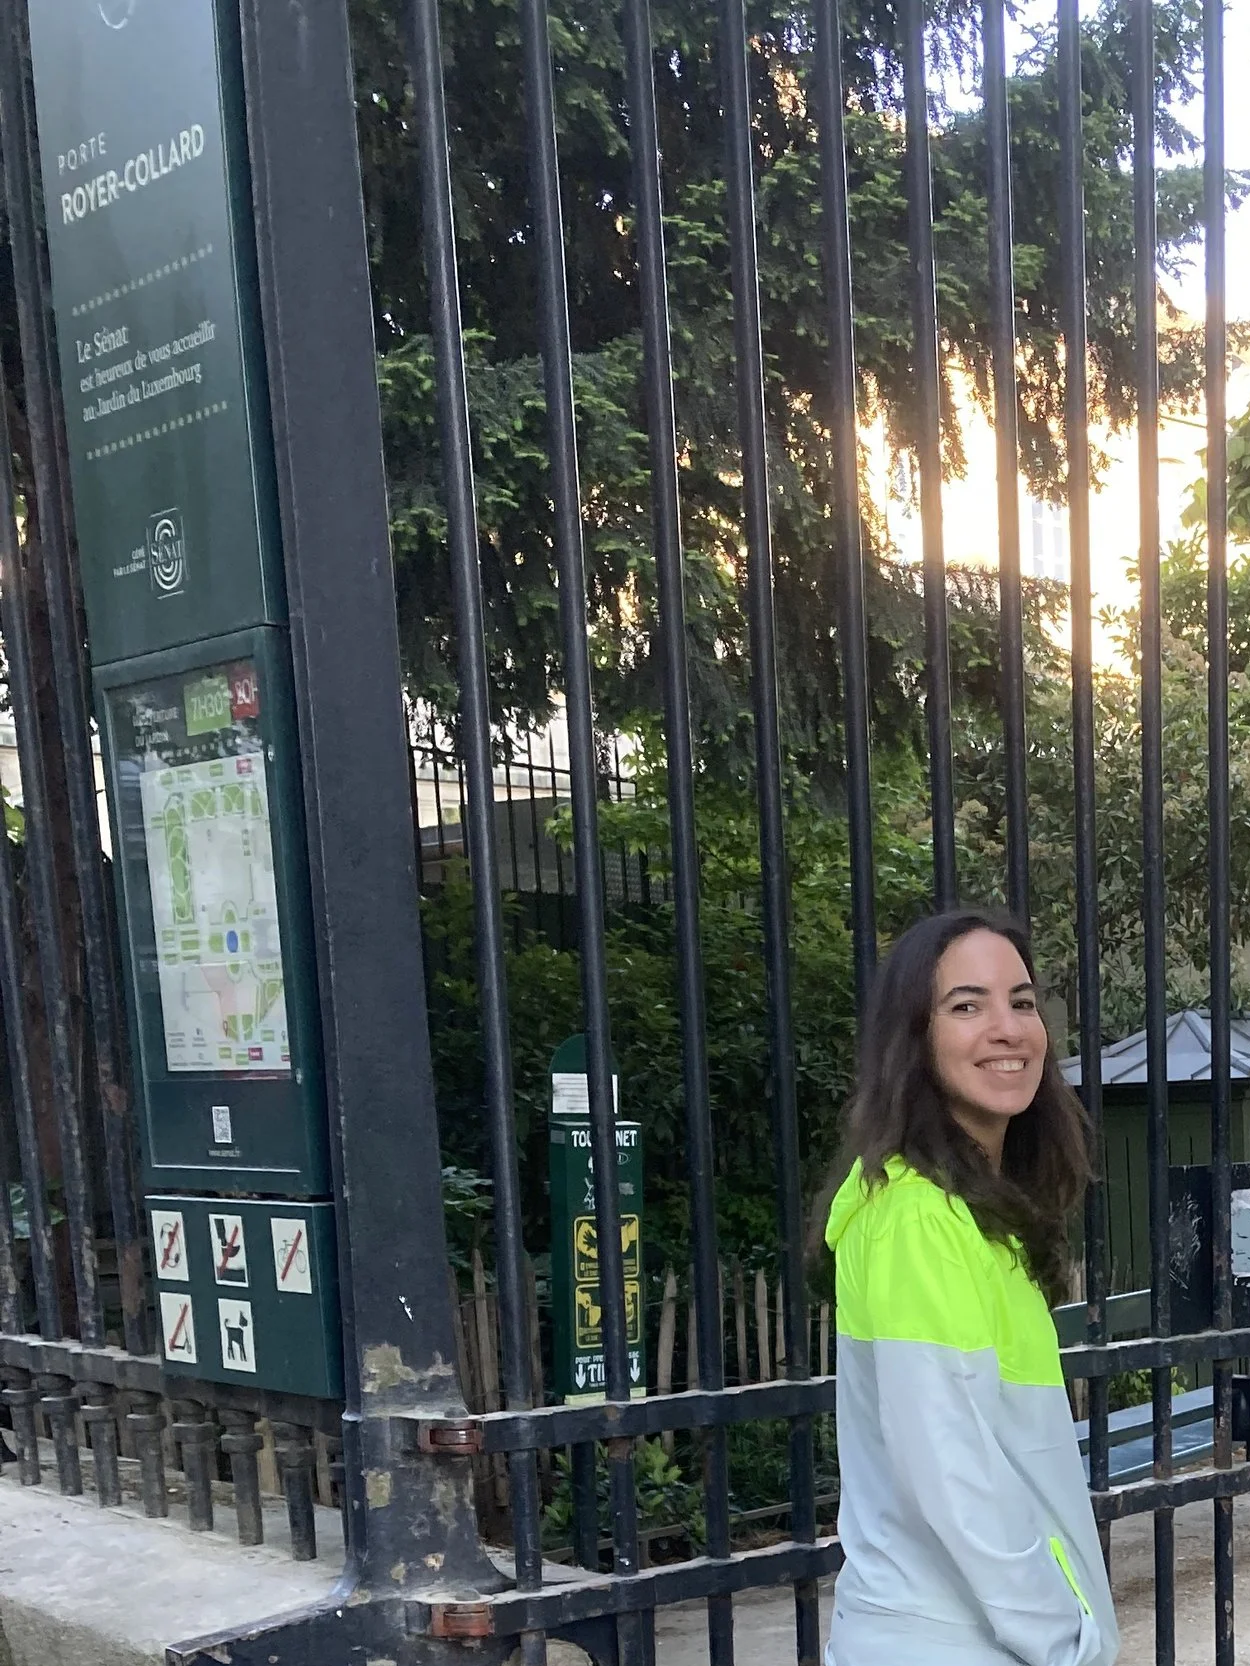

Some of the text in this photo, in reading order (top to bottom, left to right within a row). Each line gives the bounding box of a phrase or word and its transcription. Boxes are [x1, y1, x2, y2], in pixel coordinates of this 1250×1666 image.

[57, 131, 107, 176] PORTE
[60, 123, 205, 226] ROYER-COLLARD
[76, 325, 130, 364] Le Sénat
[80, 373, 95, 393] est
[95, 358, 134, 388] heureux
[134, 350, 147, 371] de
[148, 342, 172, 365] vous
[83, 362, 203, 422] au Jardin du Luxembourg
